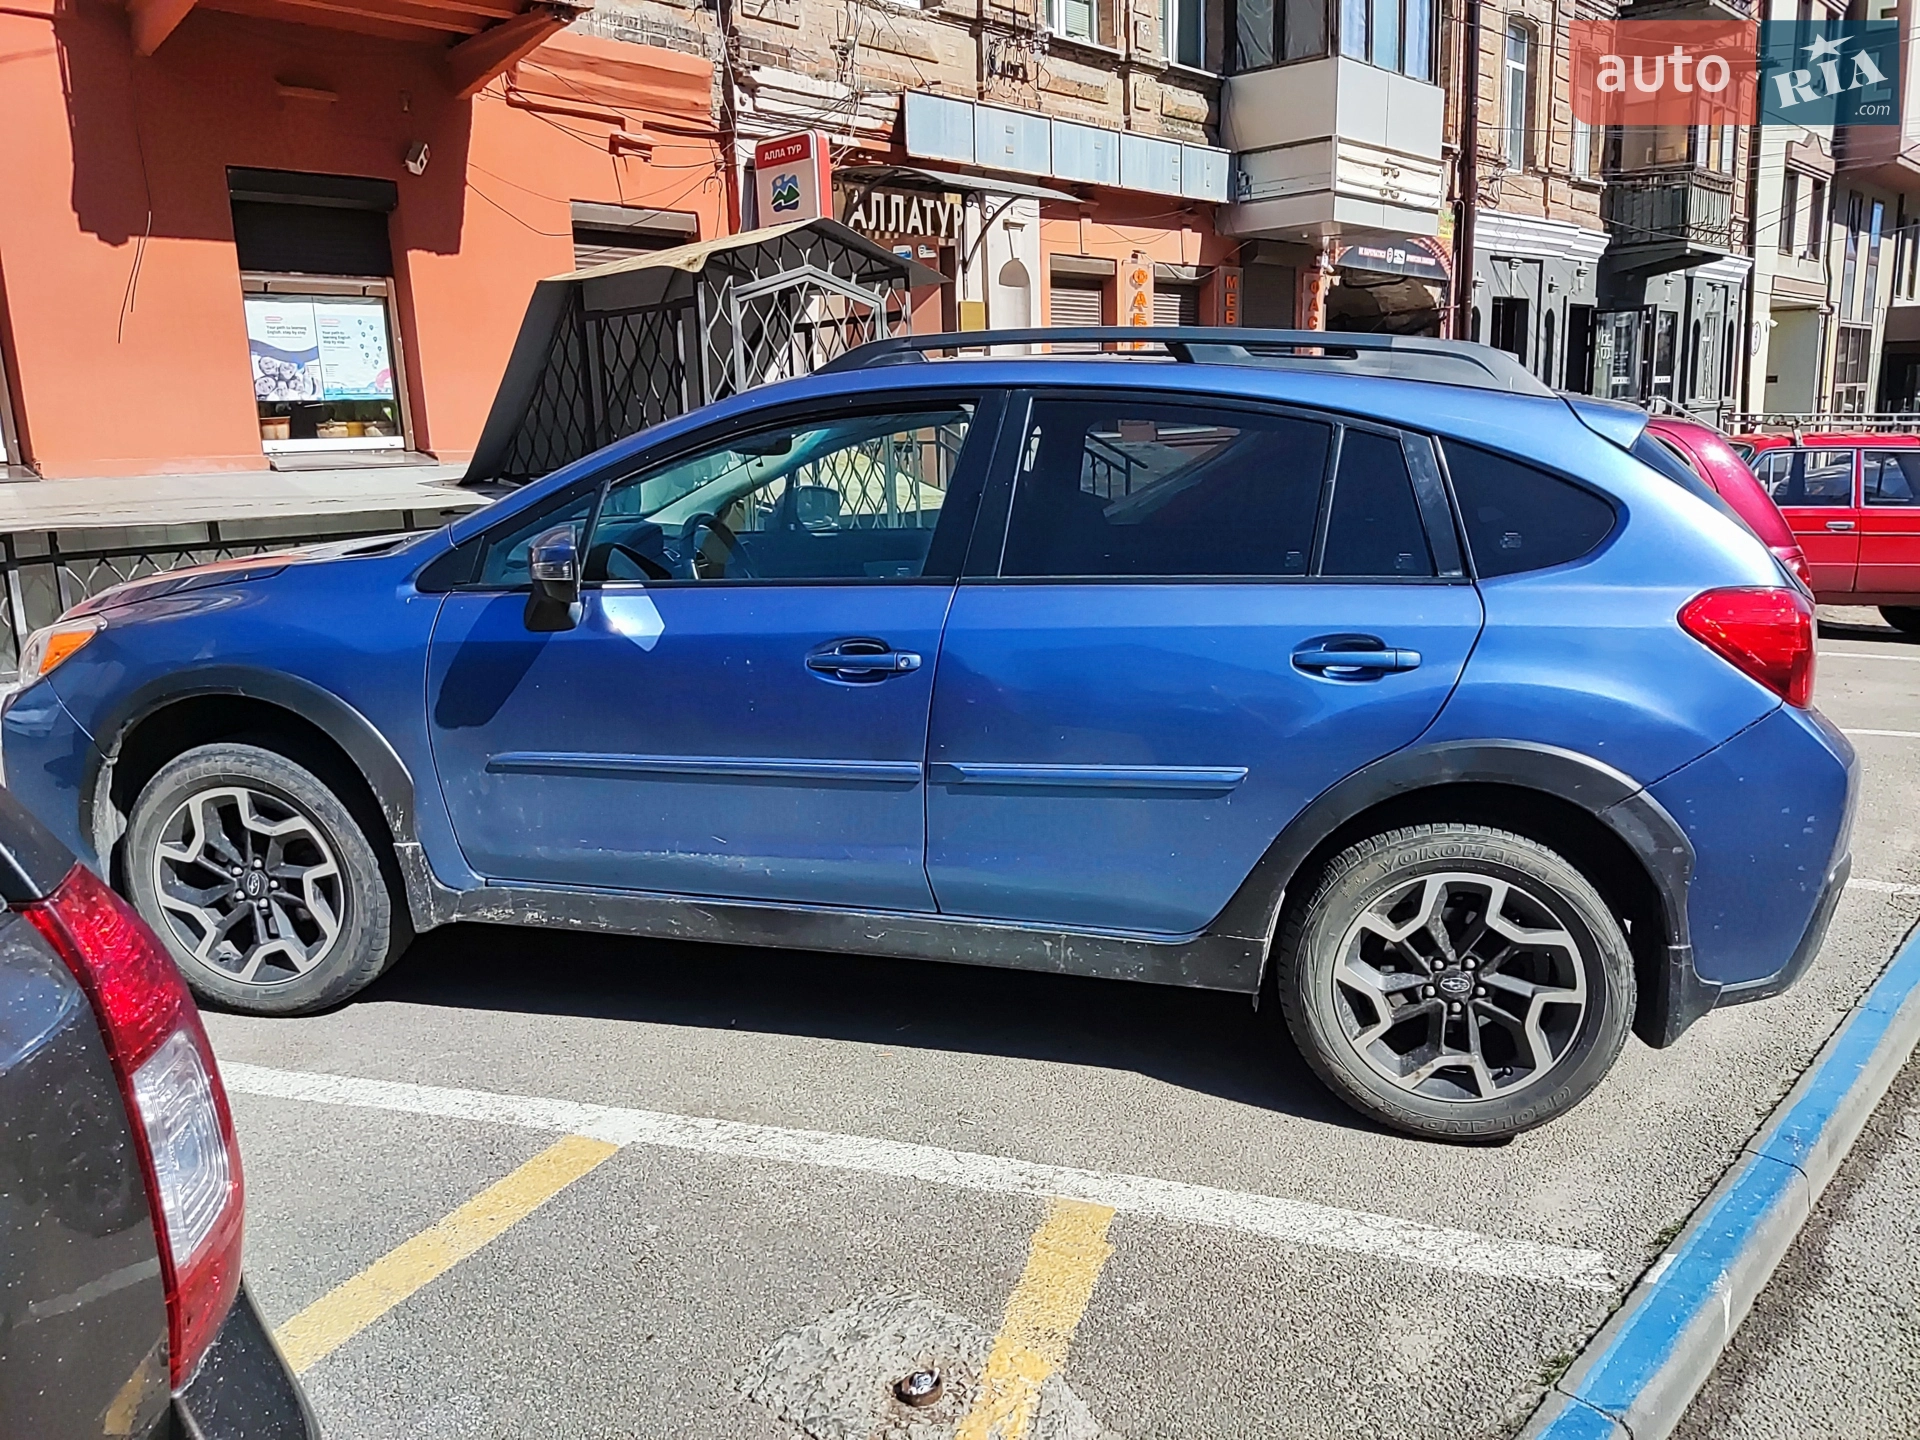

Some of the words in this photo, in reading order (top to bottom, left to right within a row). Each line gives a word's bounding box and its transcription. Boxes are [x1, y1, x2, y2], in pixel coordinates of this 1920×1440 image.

[764, 147, 786, 161] АЛЛА
[786, 144, 802, 156] ТУР
[1378, 844, 1549, 881] YOKOHAMA
